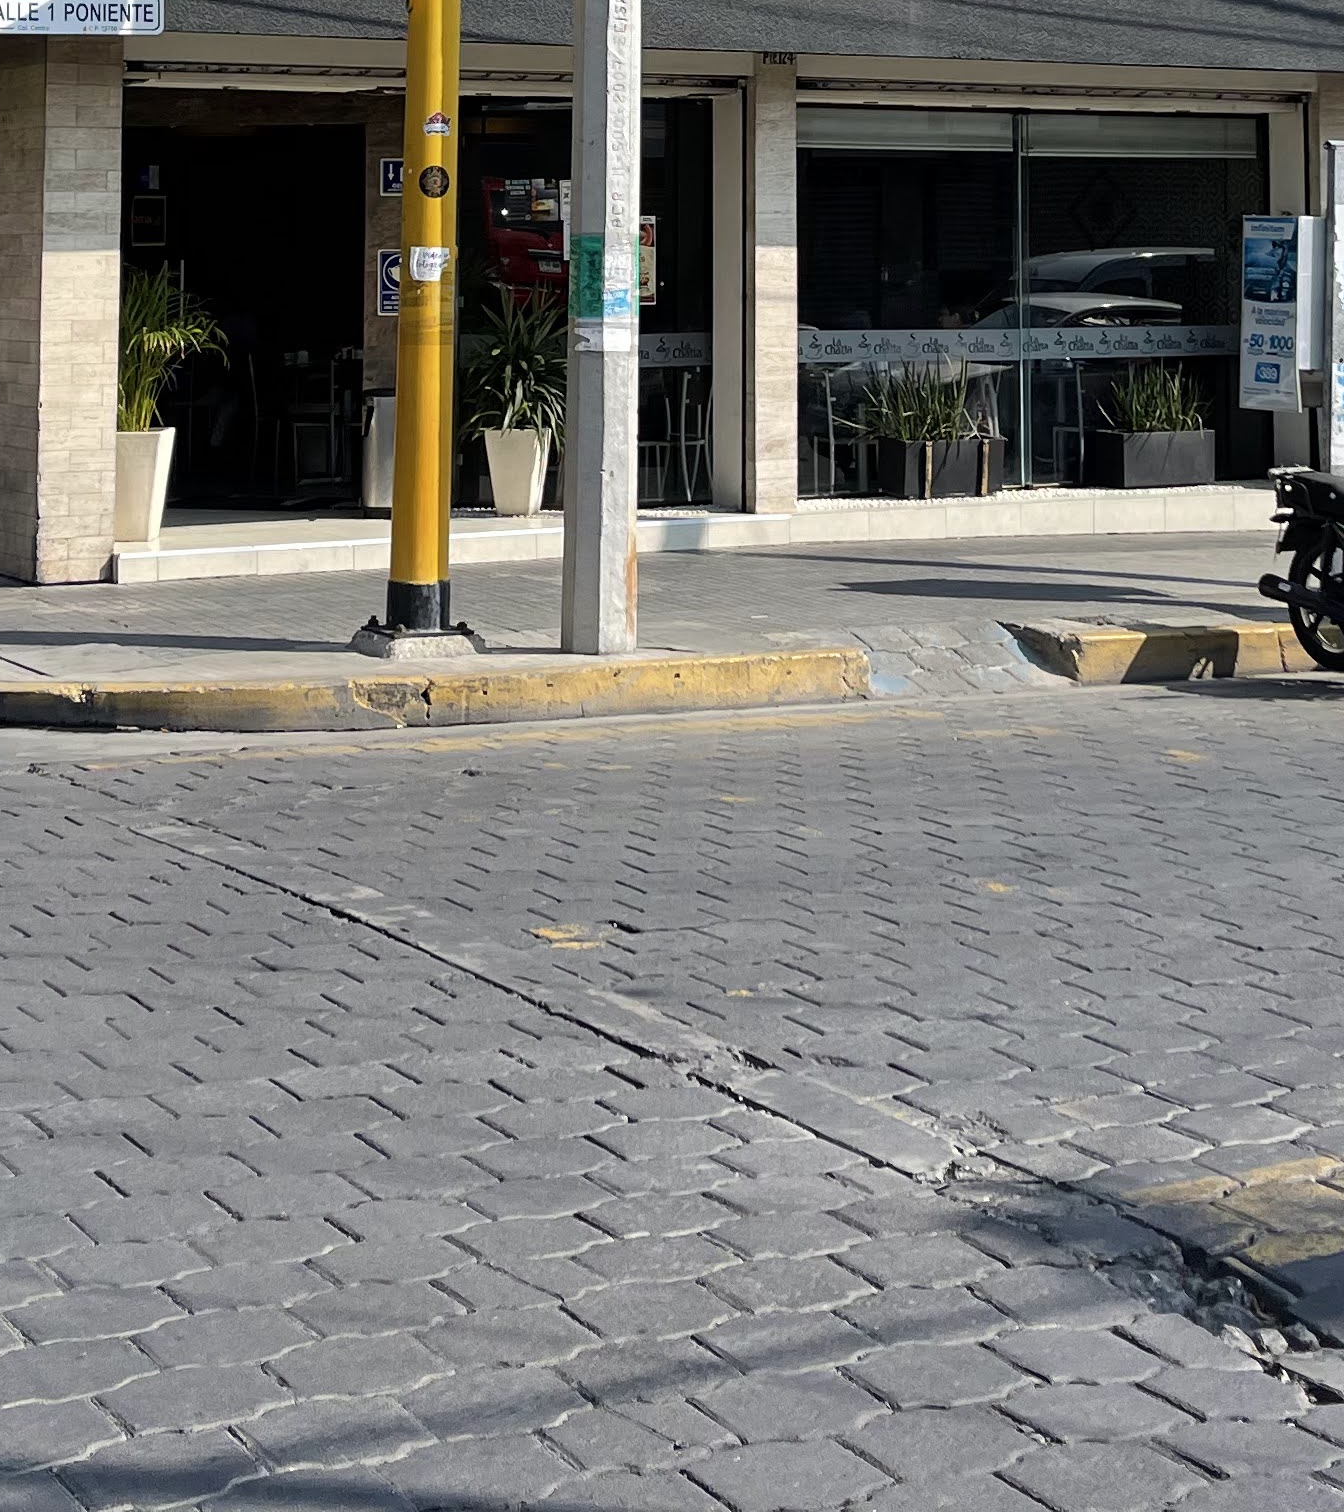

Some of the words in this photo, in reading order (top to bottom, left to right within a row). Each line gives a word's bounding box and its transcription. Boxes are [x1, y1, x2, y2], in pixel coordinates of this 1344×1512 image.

[47, 3, 54, 21] 1
[64, 2, 154, 23] PONIENTE
[1248, 333, 1264, 348] 50
[1269, 335, 1294, 350] 1000
